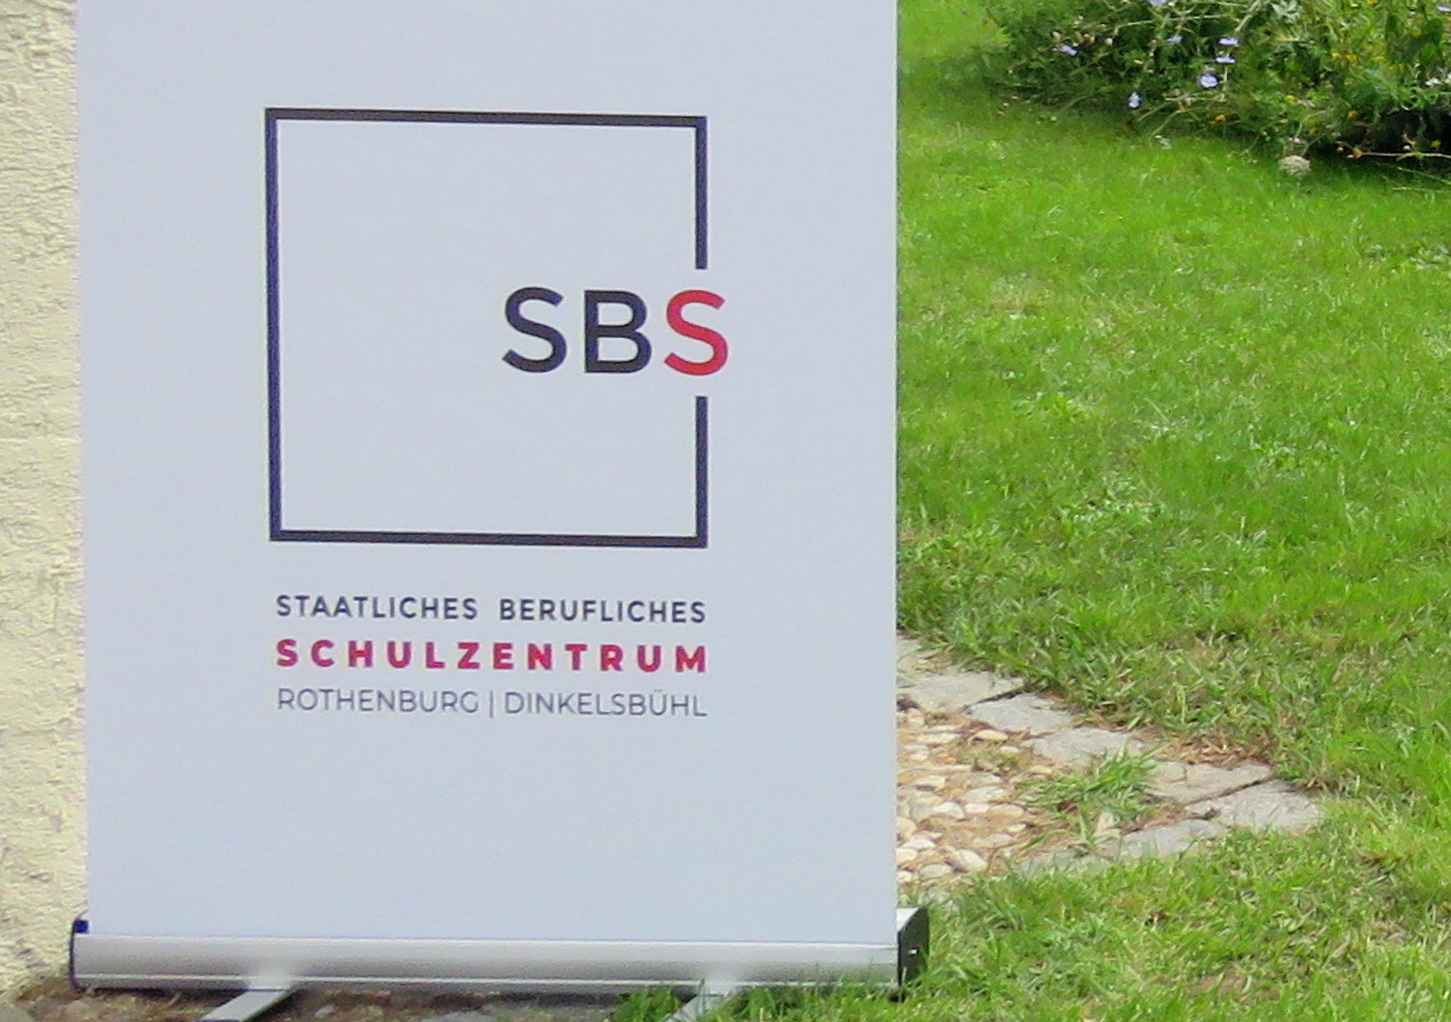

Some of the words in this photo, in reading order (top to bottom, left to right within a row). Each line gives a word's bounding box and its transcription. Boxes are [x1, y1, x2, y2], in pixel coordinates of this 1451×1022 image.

[501, 285, 729, 377] SBS
[275, 594, 478, 621] STAATLICHES
[499, 598, 706, 624] BERUFLICHES
[275, 638, 706, 674] SCHULZENTRUM
[277, 687, 479, 714] ROTHENBURG
[504, 683, 708, 718] DINKELSBÜHL
